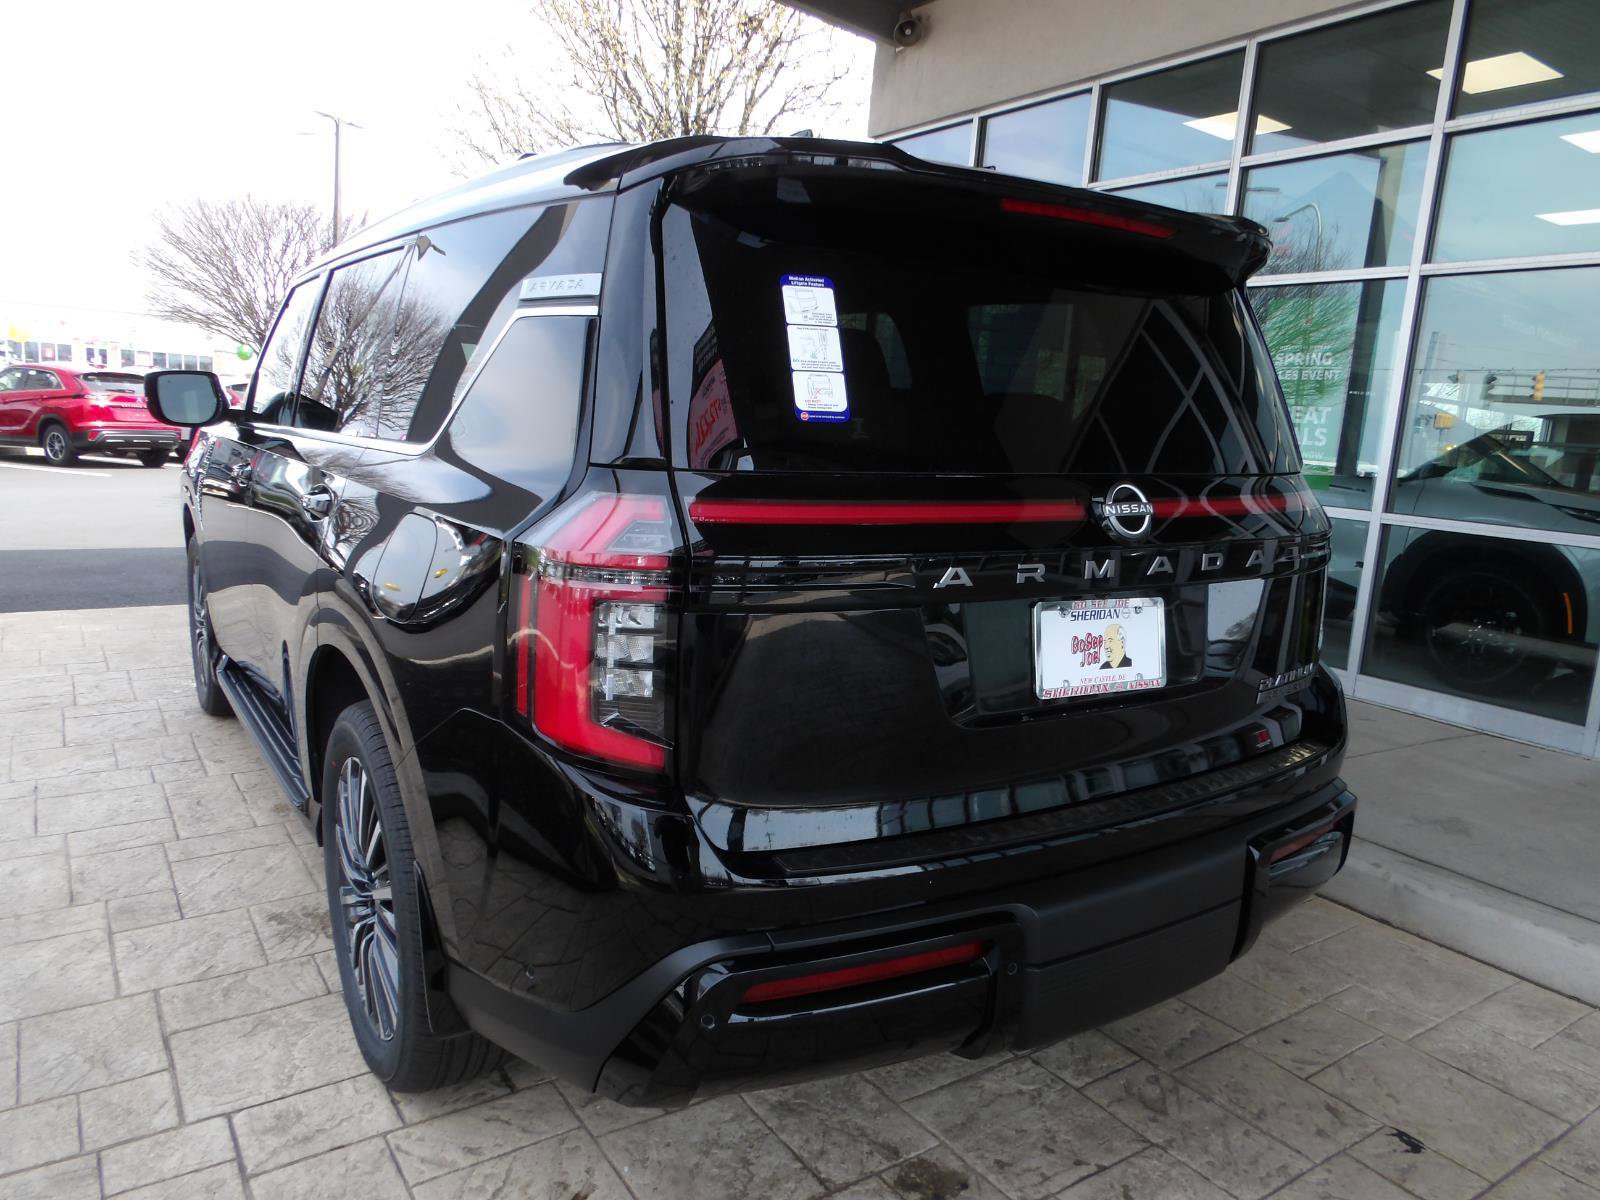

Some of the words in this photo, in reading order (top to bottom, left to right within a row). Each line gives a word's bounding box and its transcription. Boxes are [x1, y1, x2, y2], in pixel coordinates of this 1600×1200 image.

[1275, 352, 1332, 366] SPRING
[1277, 369, 1299, 380] LES
[1301, 369, 1341, 381] EVENT
[1291, 405, 1333, 425] EAT
[1105, 503, 1153, 515] NISSAN
[933, 550, 1271, 588] ARMADA
[1070, 608, 1120, 621] SHERIDAN
